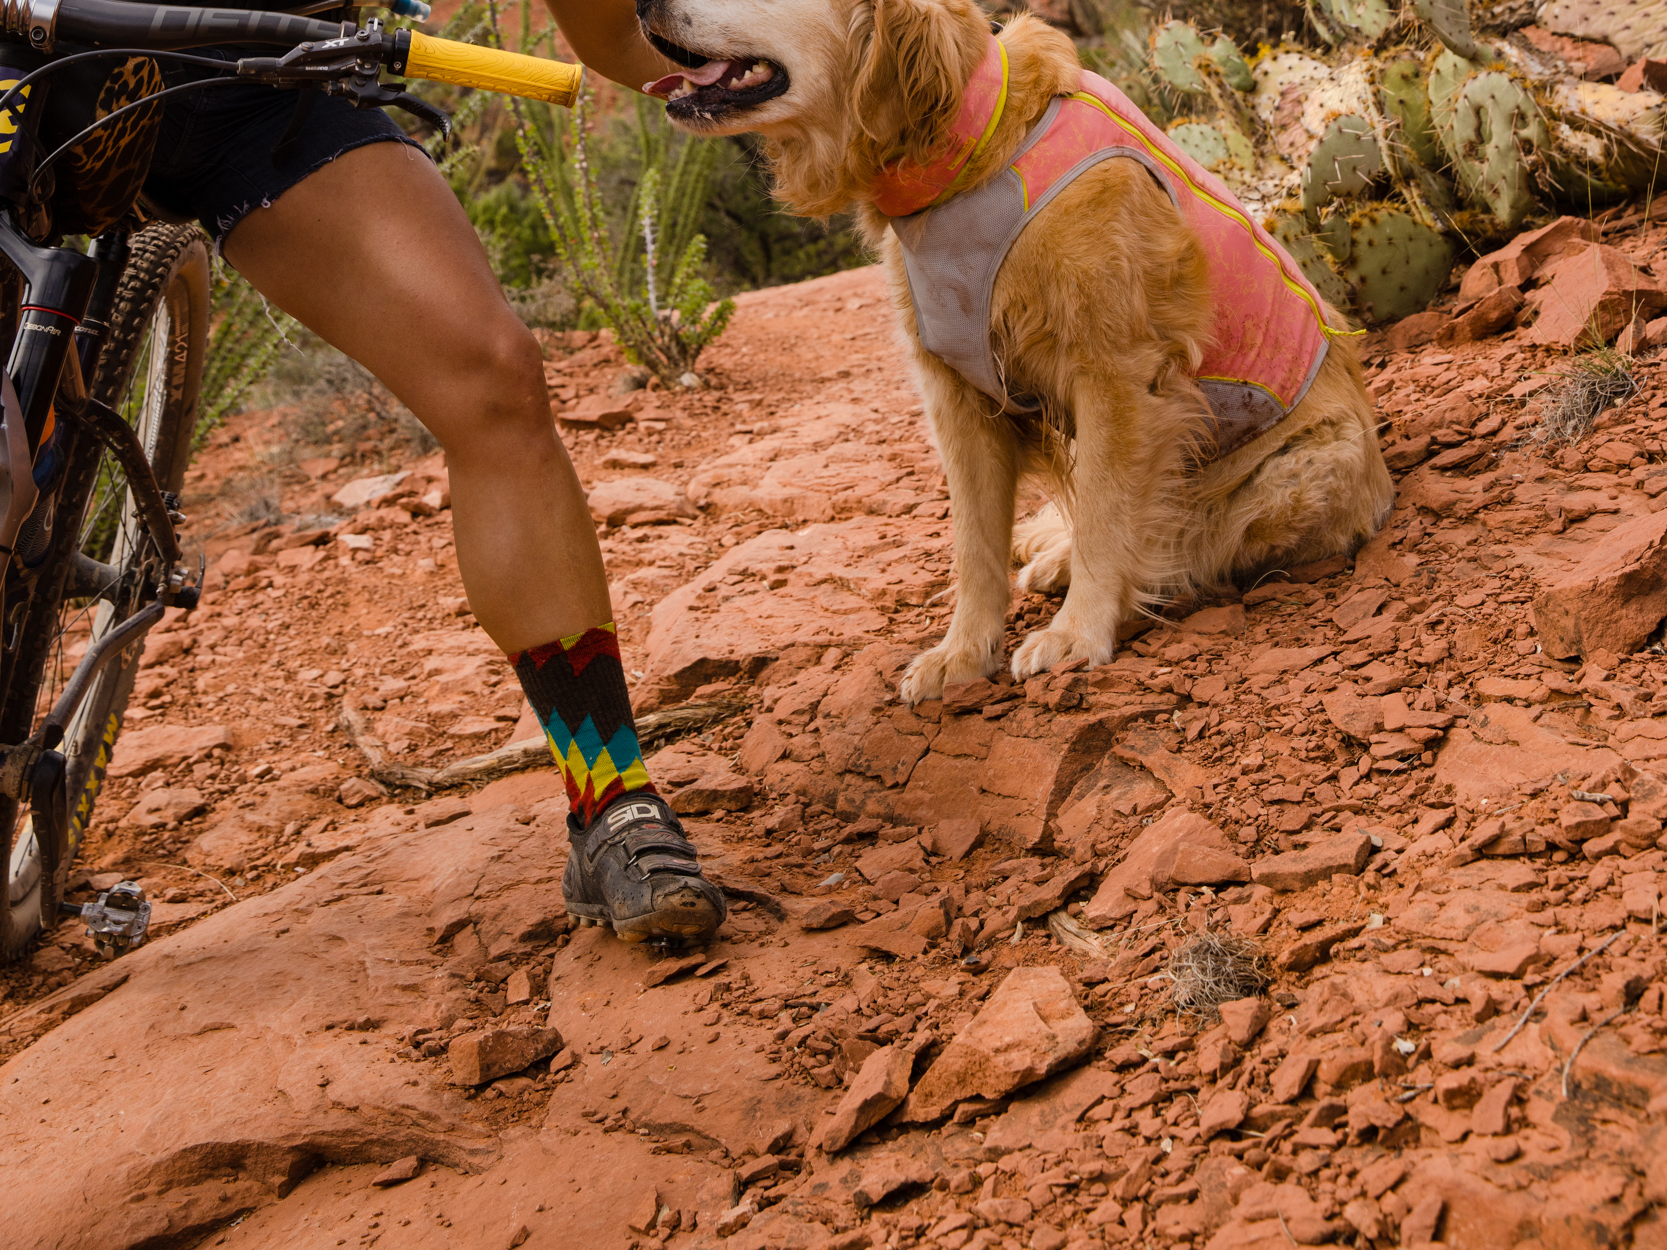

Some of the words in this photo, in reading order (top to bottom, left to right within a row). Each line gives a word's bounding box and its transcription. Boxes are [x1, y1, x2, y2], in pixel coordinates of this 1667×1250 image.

[321, 37, 350, 49] XT
[68, 712, 119, 850] MAXXIS
[607, 803, 662, 832] SIDI
